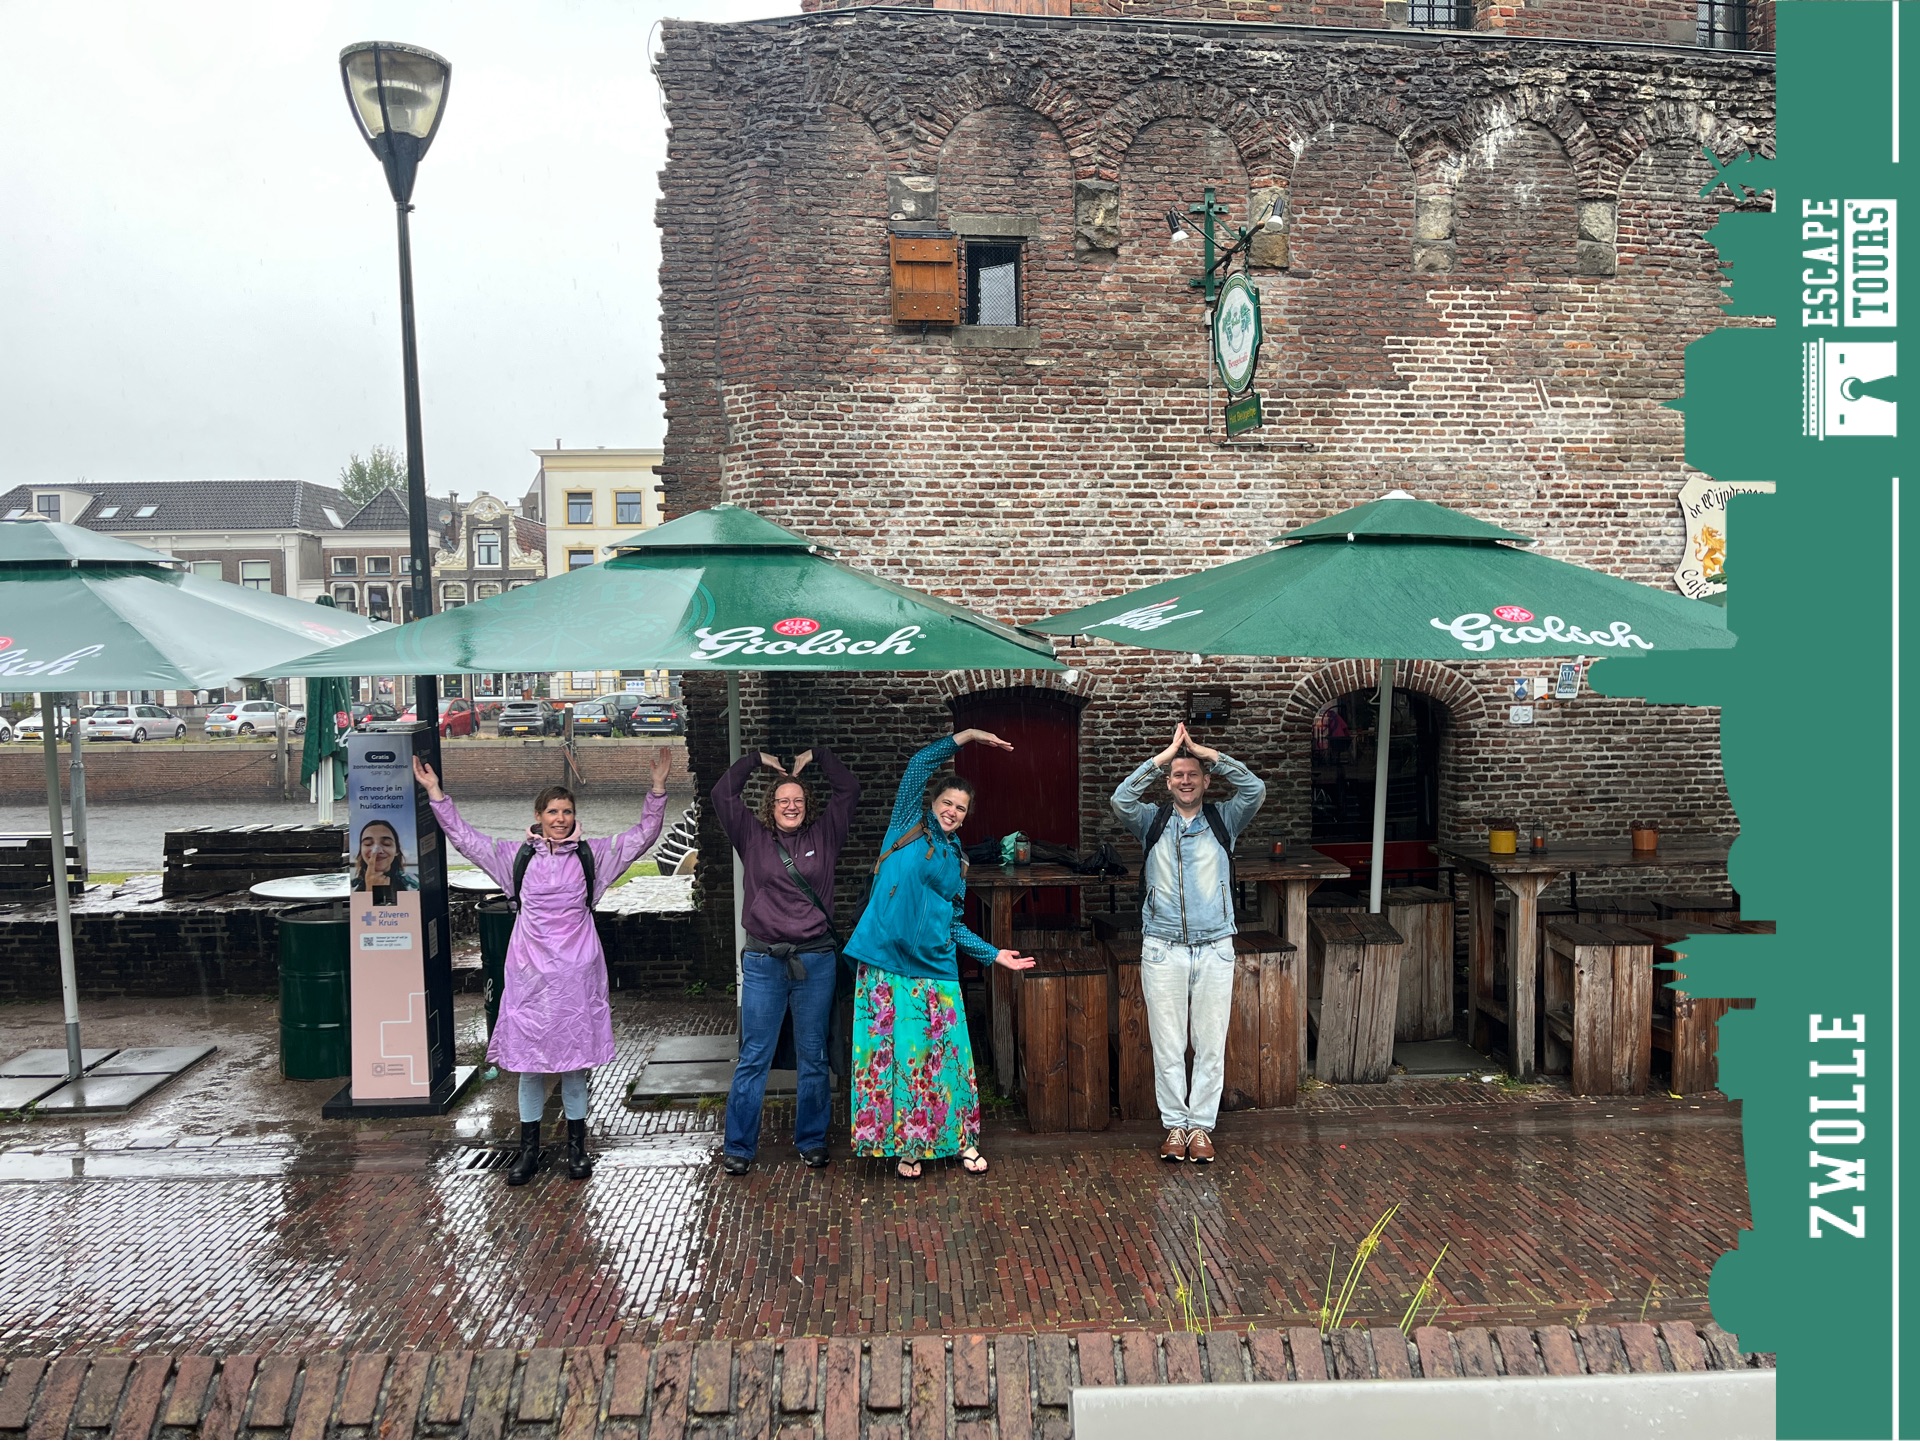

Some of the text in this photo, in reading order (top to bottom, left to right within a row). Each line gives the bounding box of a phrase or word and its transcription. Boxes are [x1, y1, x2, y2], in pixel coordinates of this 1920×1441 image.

[1685, 502, 1703, 518] de
[690, 626, 922, 660] Grolsch
[1430, 613, 1654, 651] Grolsch
[1511, 707, 1531, 722] 63
